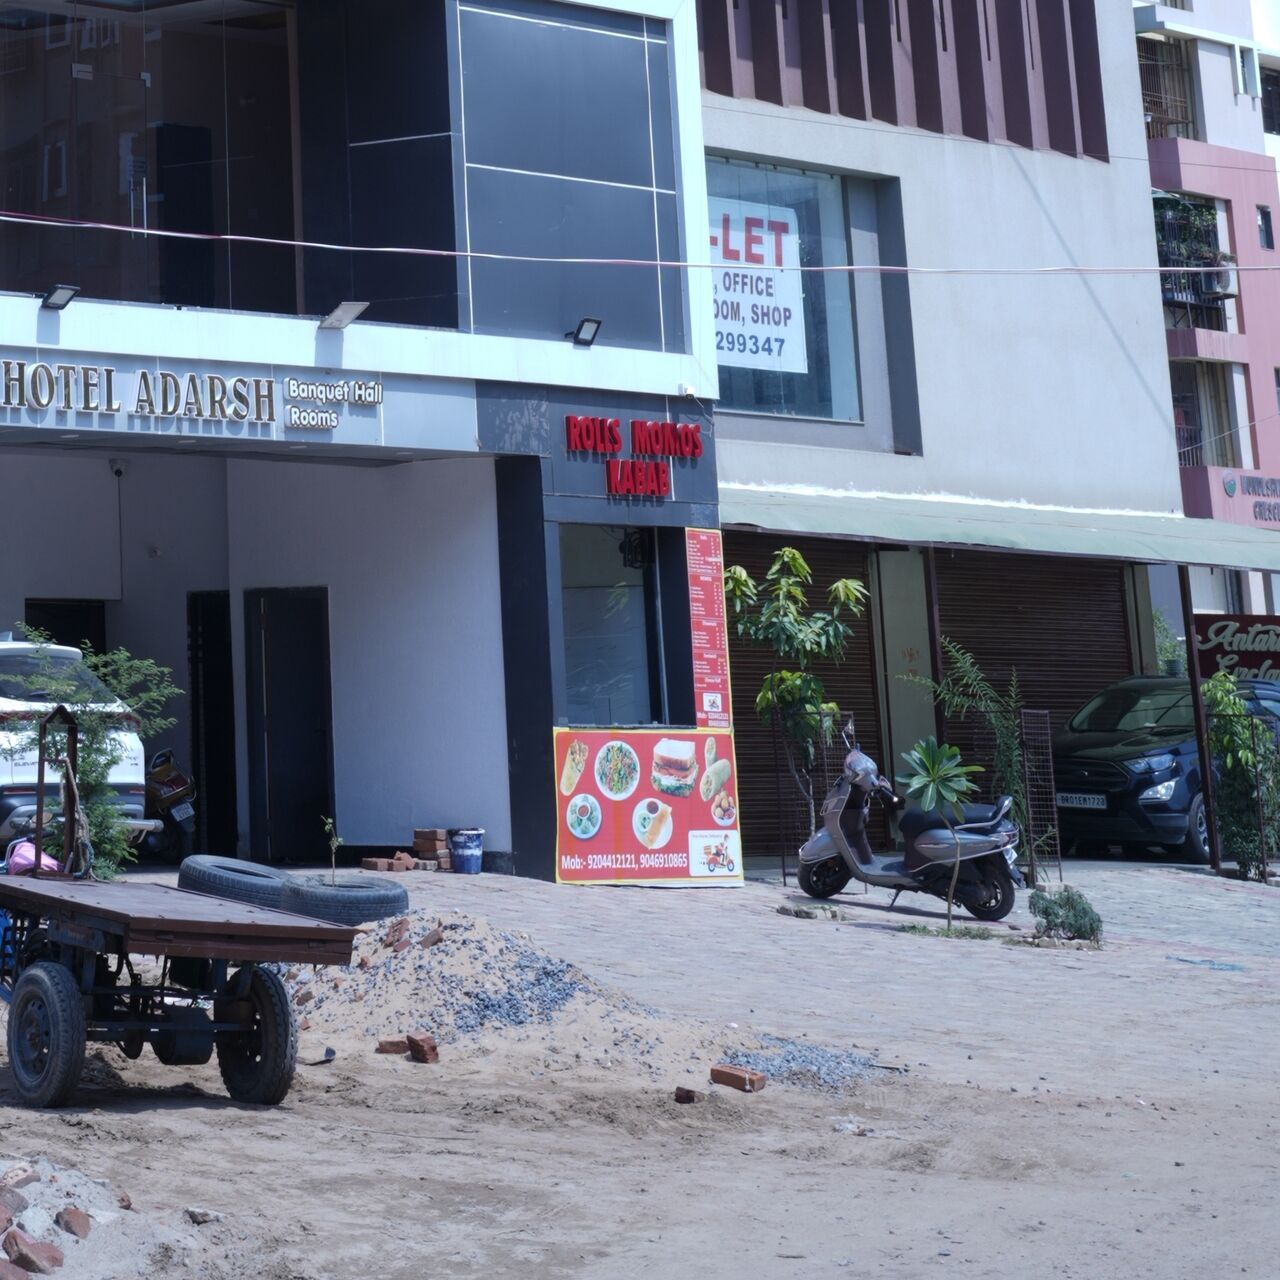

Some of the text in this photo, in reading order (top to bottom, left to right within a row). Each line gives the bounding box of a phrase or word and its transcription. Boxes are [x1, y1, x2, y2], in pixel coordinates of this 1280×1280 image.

[723, 271, 774, 297] OFFICE
[751, 303, 792, 327] SHOP
[716, 331, 785, 357] 299347
[134, 369, 276, 423] ADARSH
[286, 378, 383, 404] Banquet Hall
[287, 405, 339, 428] Rooms
[566, 415, 703, 458] ROLLS MOMOS
[606, 459, 670, 497] KABAB
[561, 854, 586, 870] Mob:-
